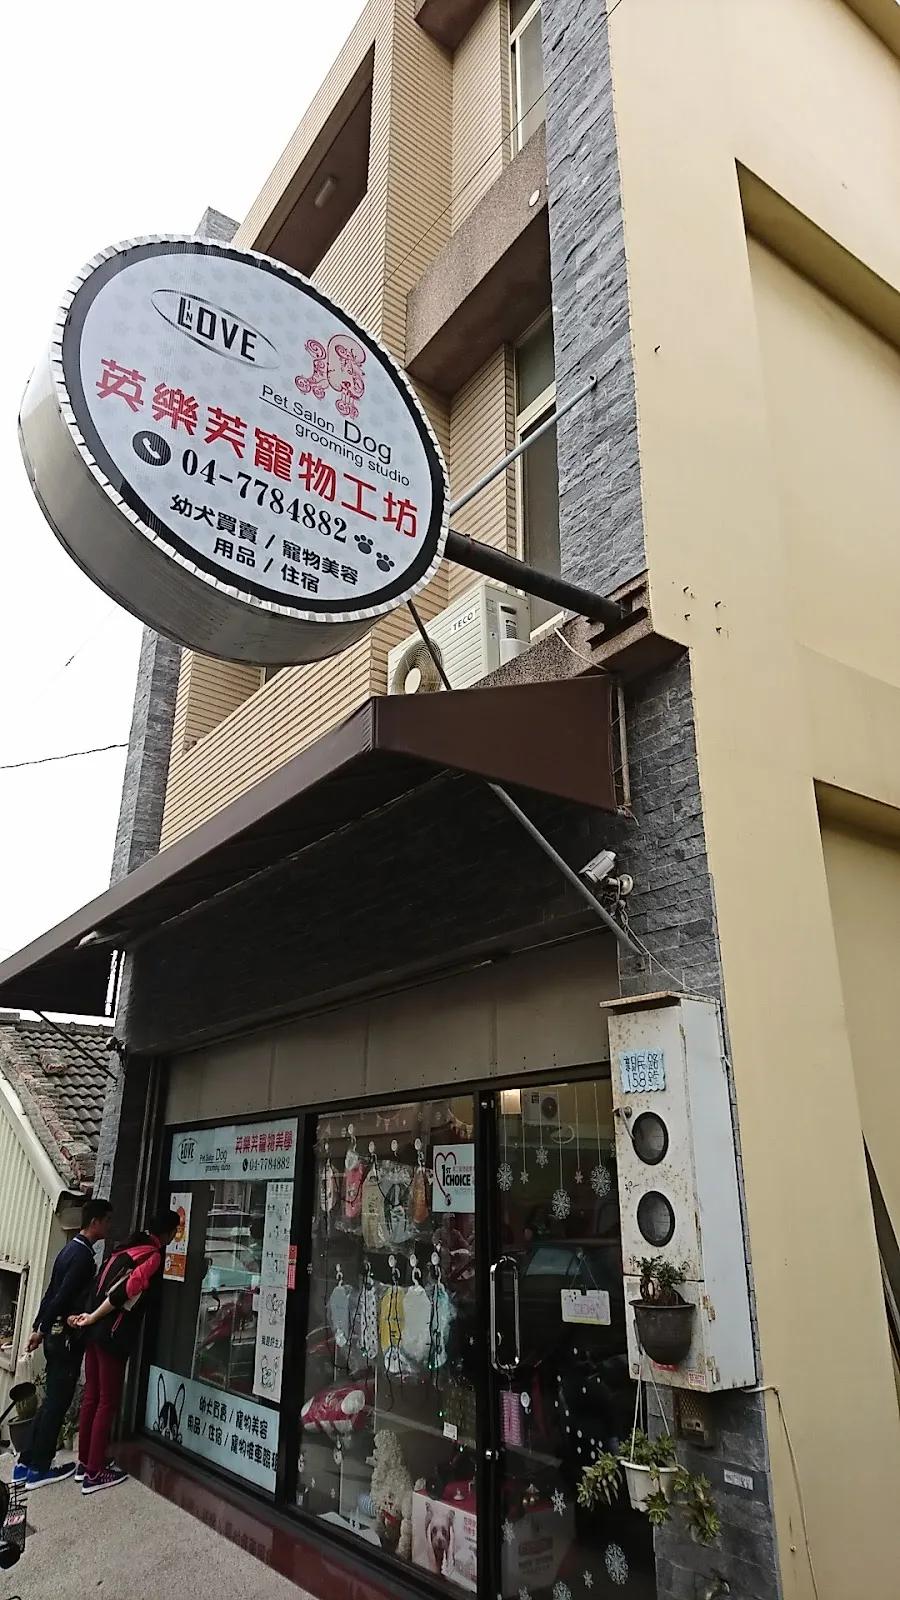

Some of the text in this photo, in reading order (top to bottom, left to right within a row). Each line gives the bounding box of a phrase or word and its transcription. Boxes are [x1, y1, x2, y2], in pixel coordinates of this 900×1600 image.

[178, 297, 257, 362] LOVE
[96, 358, 418, 538] 英樂芙寵物工坊
[262, 384, 392, 465] Pet Salon Dog
[295, 423, 410, 486] grooming studio
[182, 449, 347, 543] 04-7784882
[170, 494, 259, 545] 幼犬買賣
[282, 540, 359, 585] 寵物美容
[214, 537, 256, 568] 用品
[281, 563, 320, 594] 住宿
[453, 612, 473, 630] TECO
[215, 1148, 227, 1163] Dog
[249, 1157, 290, 1171] 04-7784882
[446, 1174, 471, 1186] CHOICE
